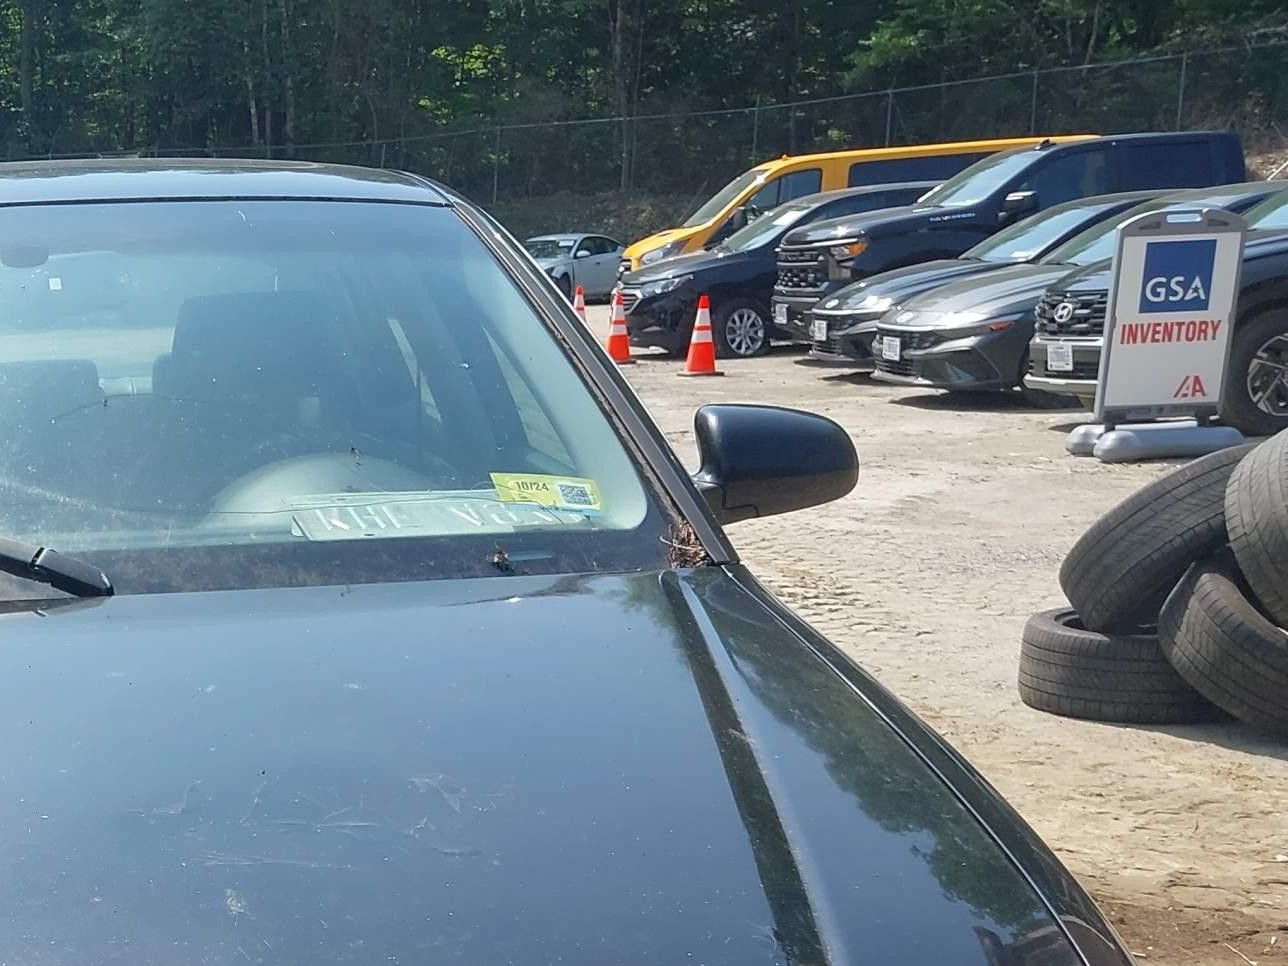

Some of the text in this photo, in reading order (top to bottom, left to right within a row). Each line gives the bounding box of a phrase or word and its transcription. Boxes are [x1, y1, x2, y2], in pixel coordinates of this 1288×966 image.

[1145, 275, 1206, 302] GSA
[1120, 320, 1222, 345] INVENTORY
[515, 481, 550, 492] 10/24
